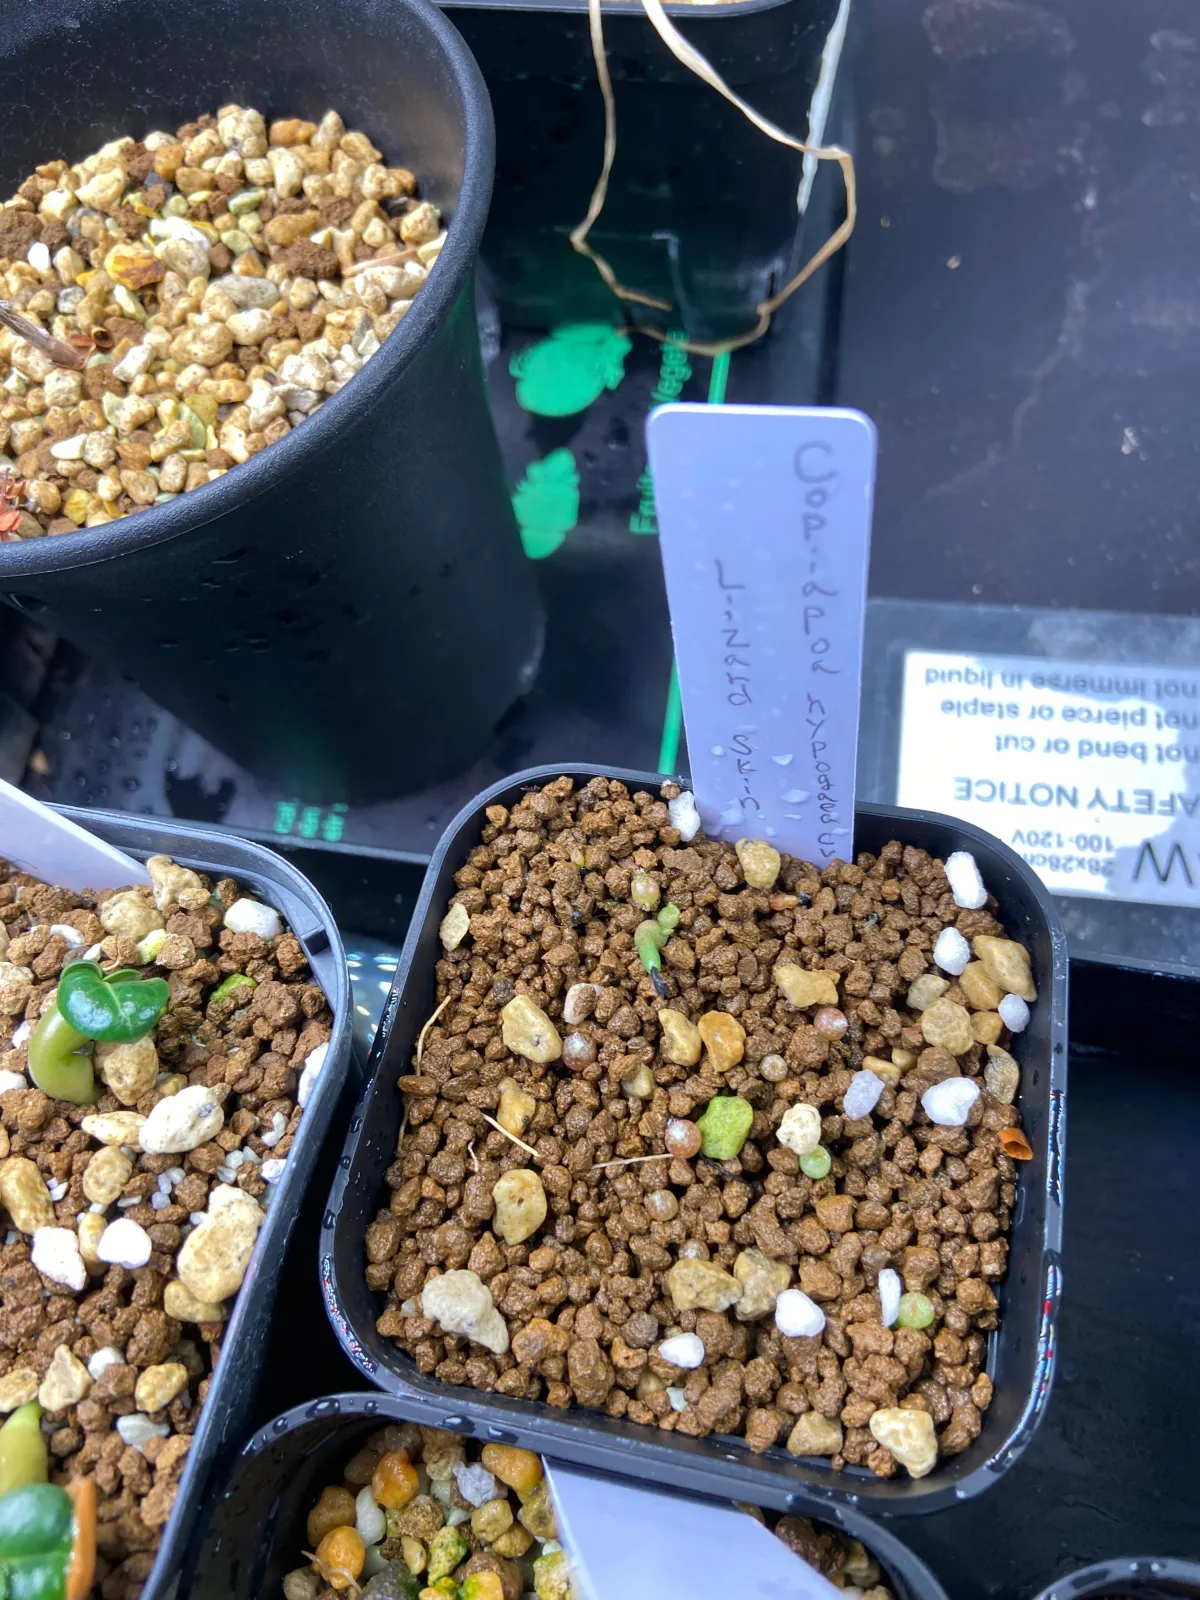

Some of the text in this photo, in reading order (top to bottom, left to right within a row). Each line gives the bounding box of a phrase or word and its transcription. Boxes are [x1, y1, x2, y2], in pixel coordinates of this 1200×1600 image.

[793, 443, 838, 676] Copiapoa
[713, 559, 752, 706] Lizard
[924, 668, 1197, 699] not immerse in liquid
[940, 698, 1198, 730] not pierce or staple
[994, 735, 1199, 764] not bend or cut
[952, 777, 1079, 808] NOTICE
[1011, 829, 1115, 853] 100-120V
